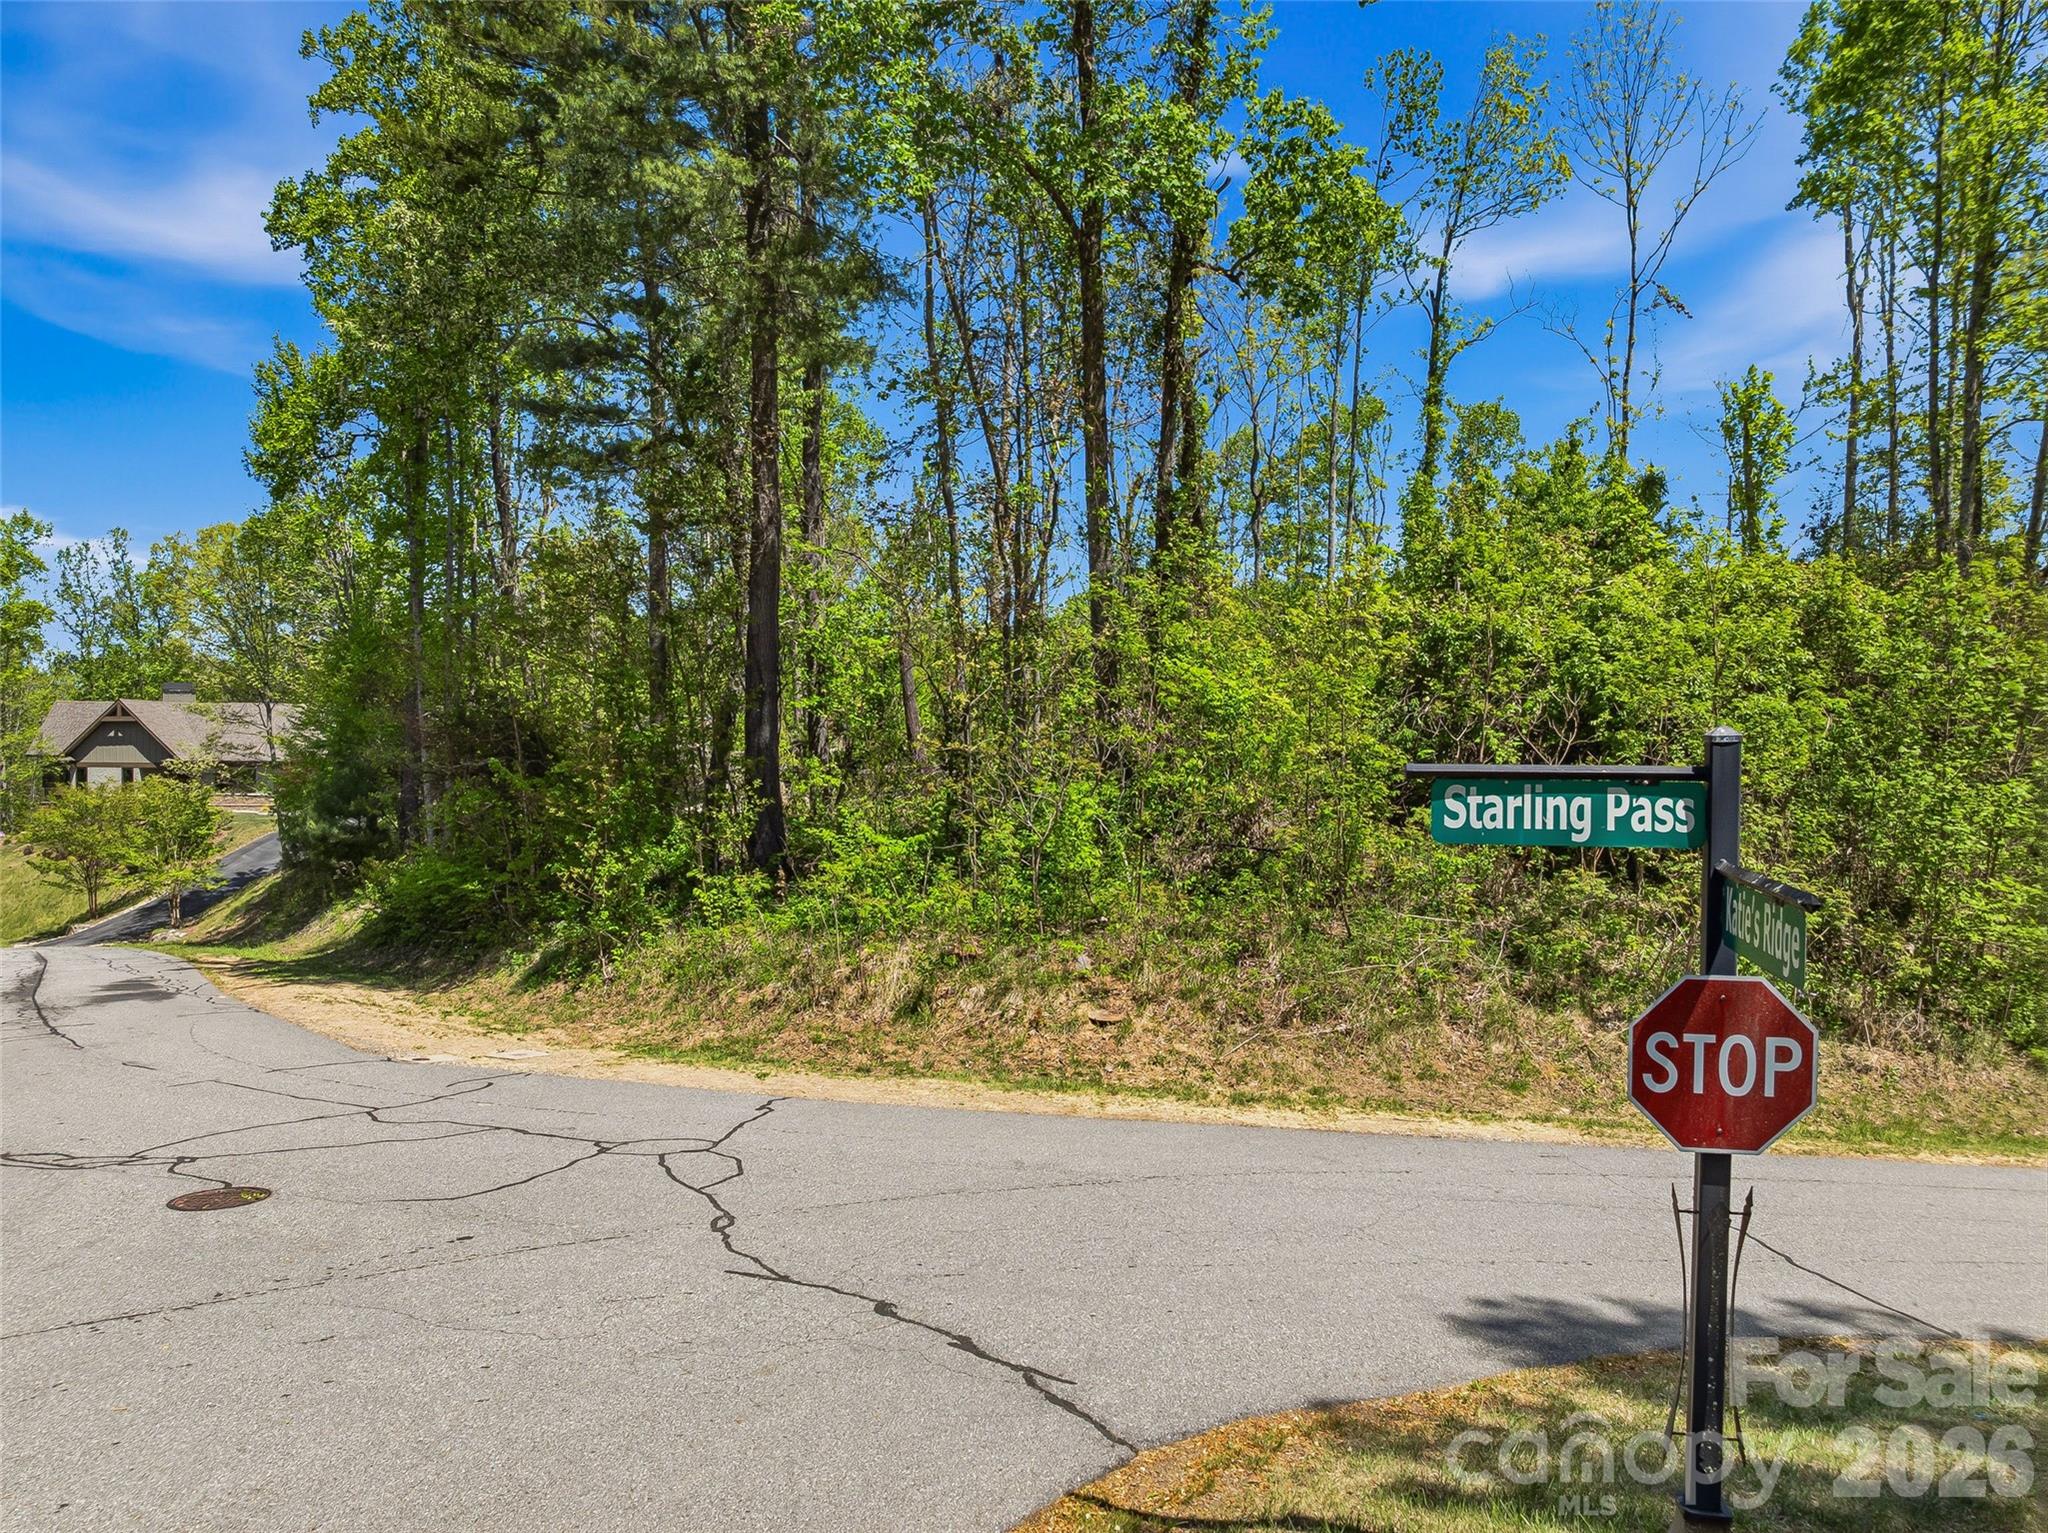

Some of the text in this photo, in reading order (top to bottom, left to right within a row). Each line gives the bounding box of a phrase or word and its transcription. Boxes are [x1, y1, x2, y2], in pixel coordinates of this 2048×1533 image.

[1443, 784, 1695, 843] Starling Pass
[1725, 886, 1801, 978] Katie's Ridge
[1642, 1031, 1802, 1097] STOP
